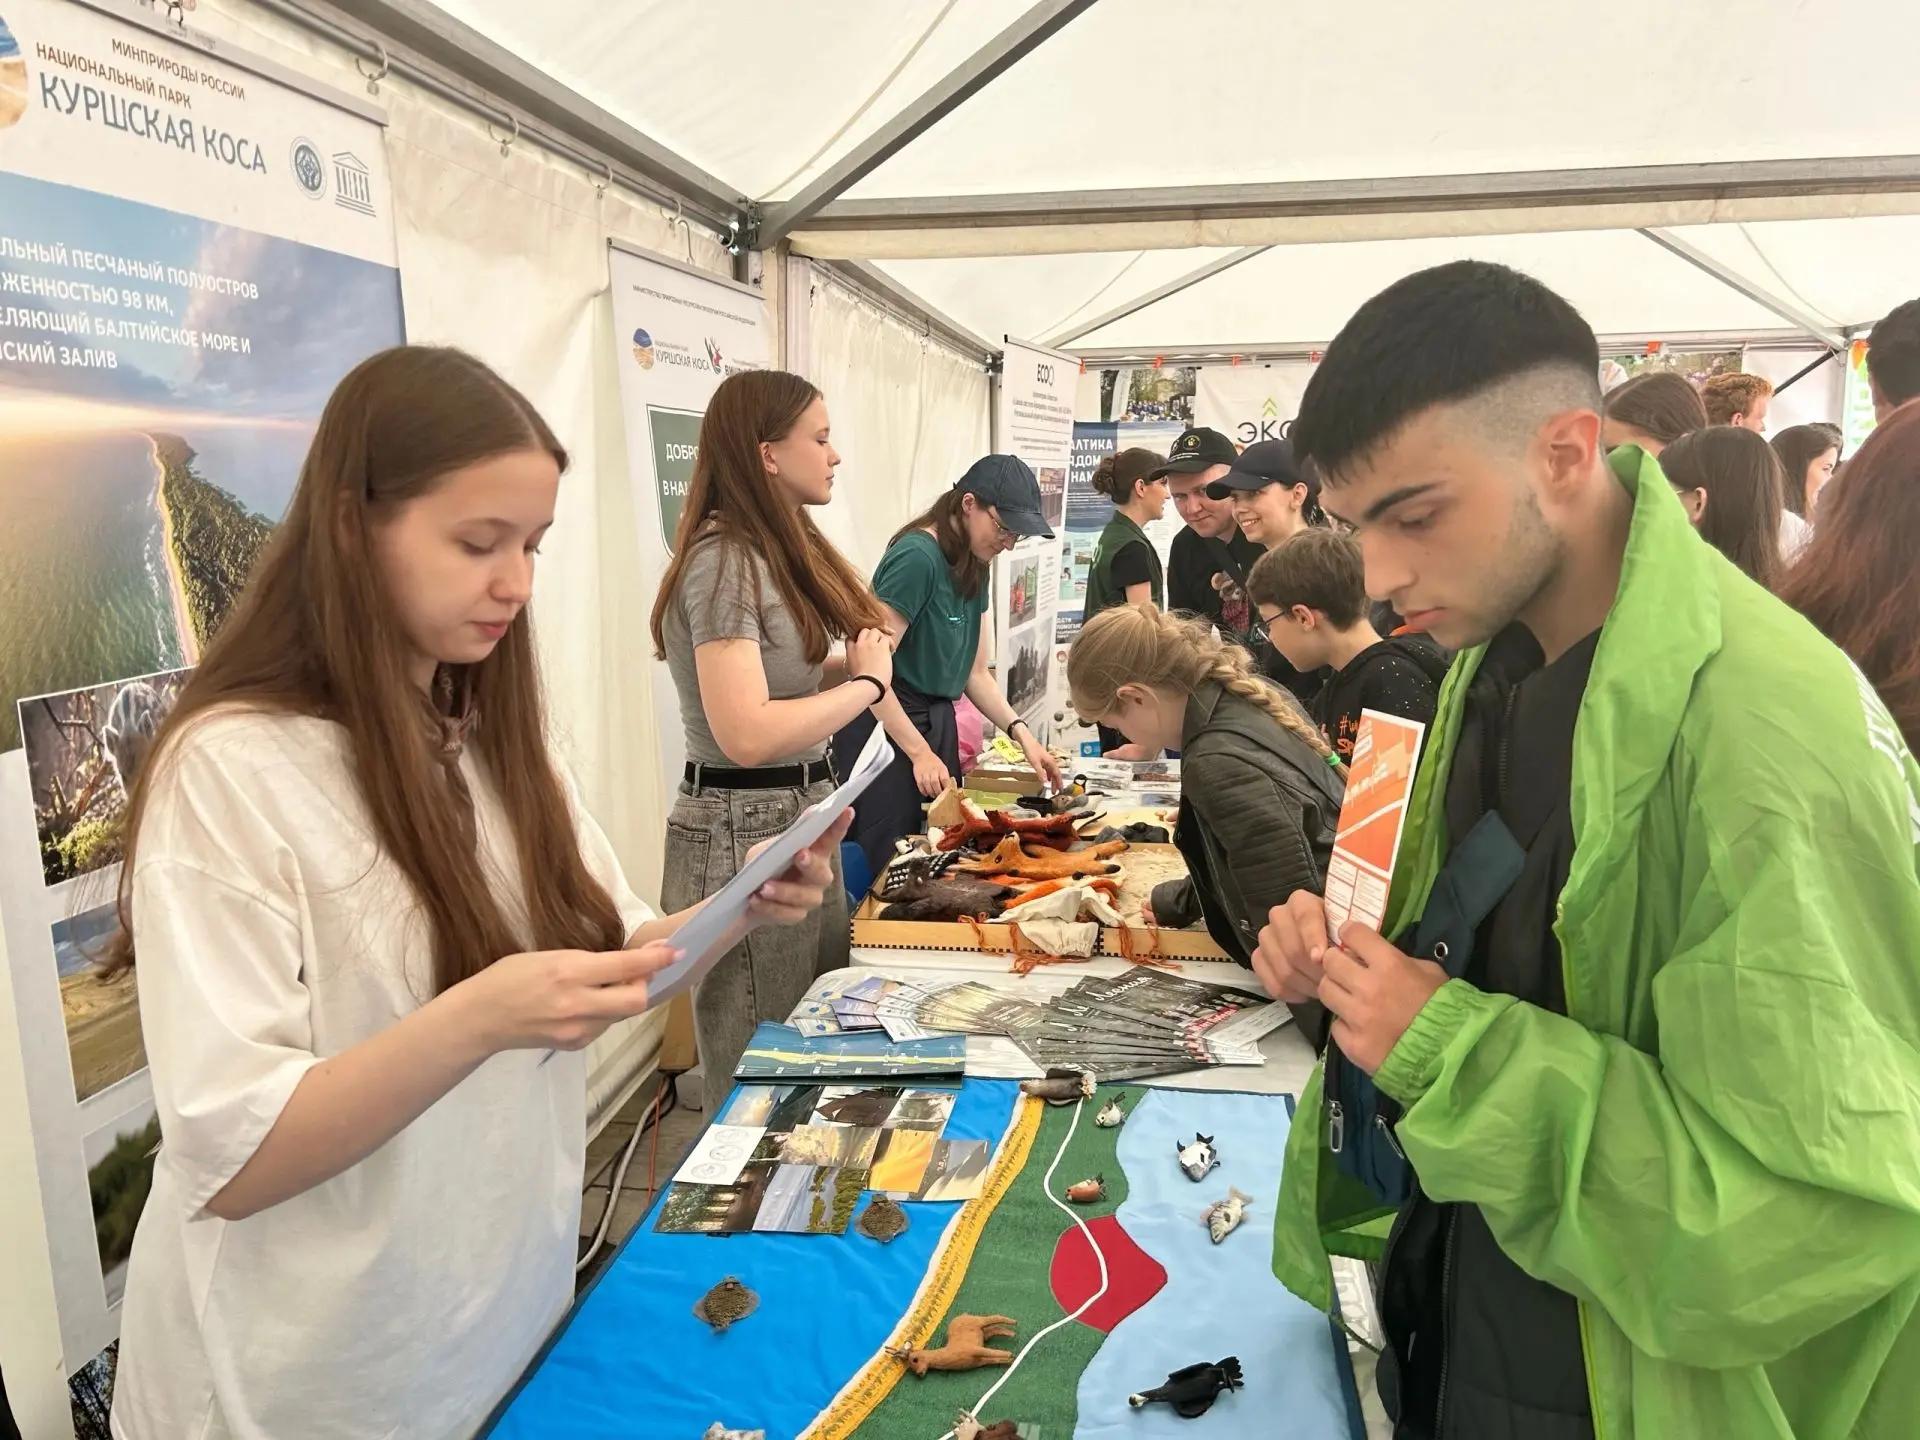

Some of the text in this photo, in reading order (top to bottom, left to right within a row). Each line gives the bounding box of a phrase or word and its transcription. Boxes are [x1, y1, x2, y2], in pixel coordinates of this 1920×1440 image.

[36, 42, 192, 109] НАЦИОНАЛЬНЫЙ ПАРК
[111, 38, 246, 101] МИНПРИРОДЫ РОССИИ
[39, 71, 268, 174] КУРШСКАЯ КОСА
[0, 271, 174, 317] ЖЕННОСТЬЮ 98 КМ,
[72, 249, 164, 284] ПЕСЧАНЫЙ
[167, 267, 259, 300] ПОЛУОСТРОВ
[0, 340, 118, 369] СКИЙ ЗАЛИВ
[95, 317, 199, 348] БАЛТИЙСКОЕ
[201, 333, 239, 353] МОРЕ
[240, 338, 251, 354] И
[655, 350, 691, 367] КУРШСКАЯ
